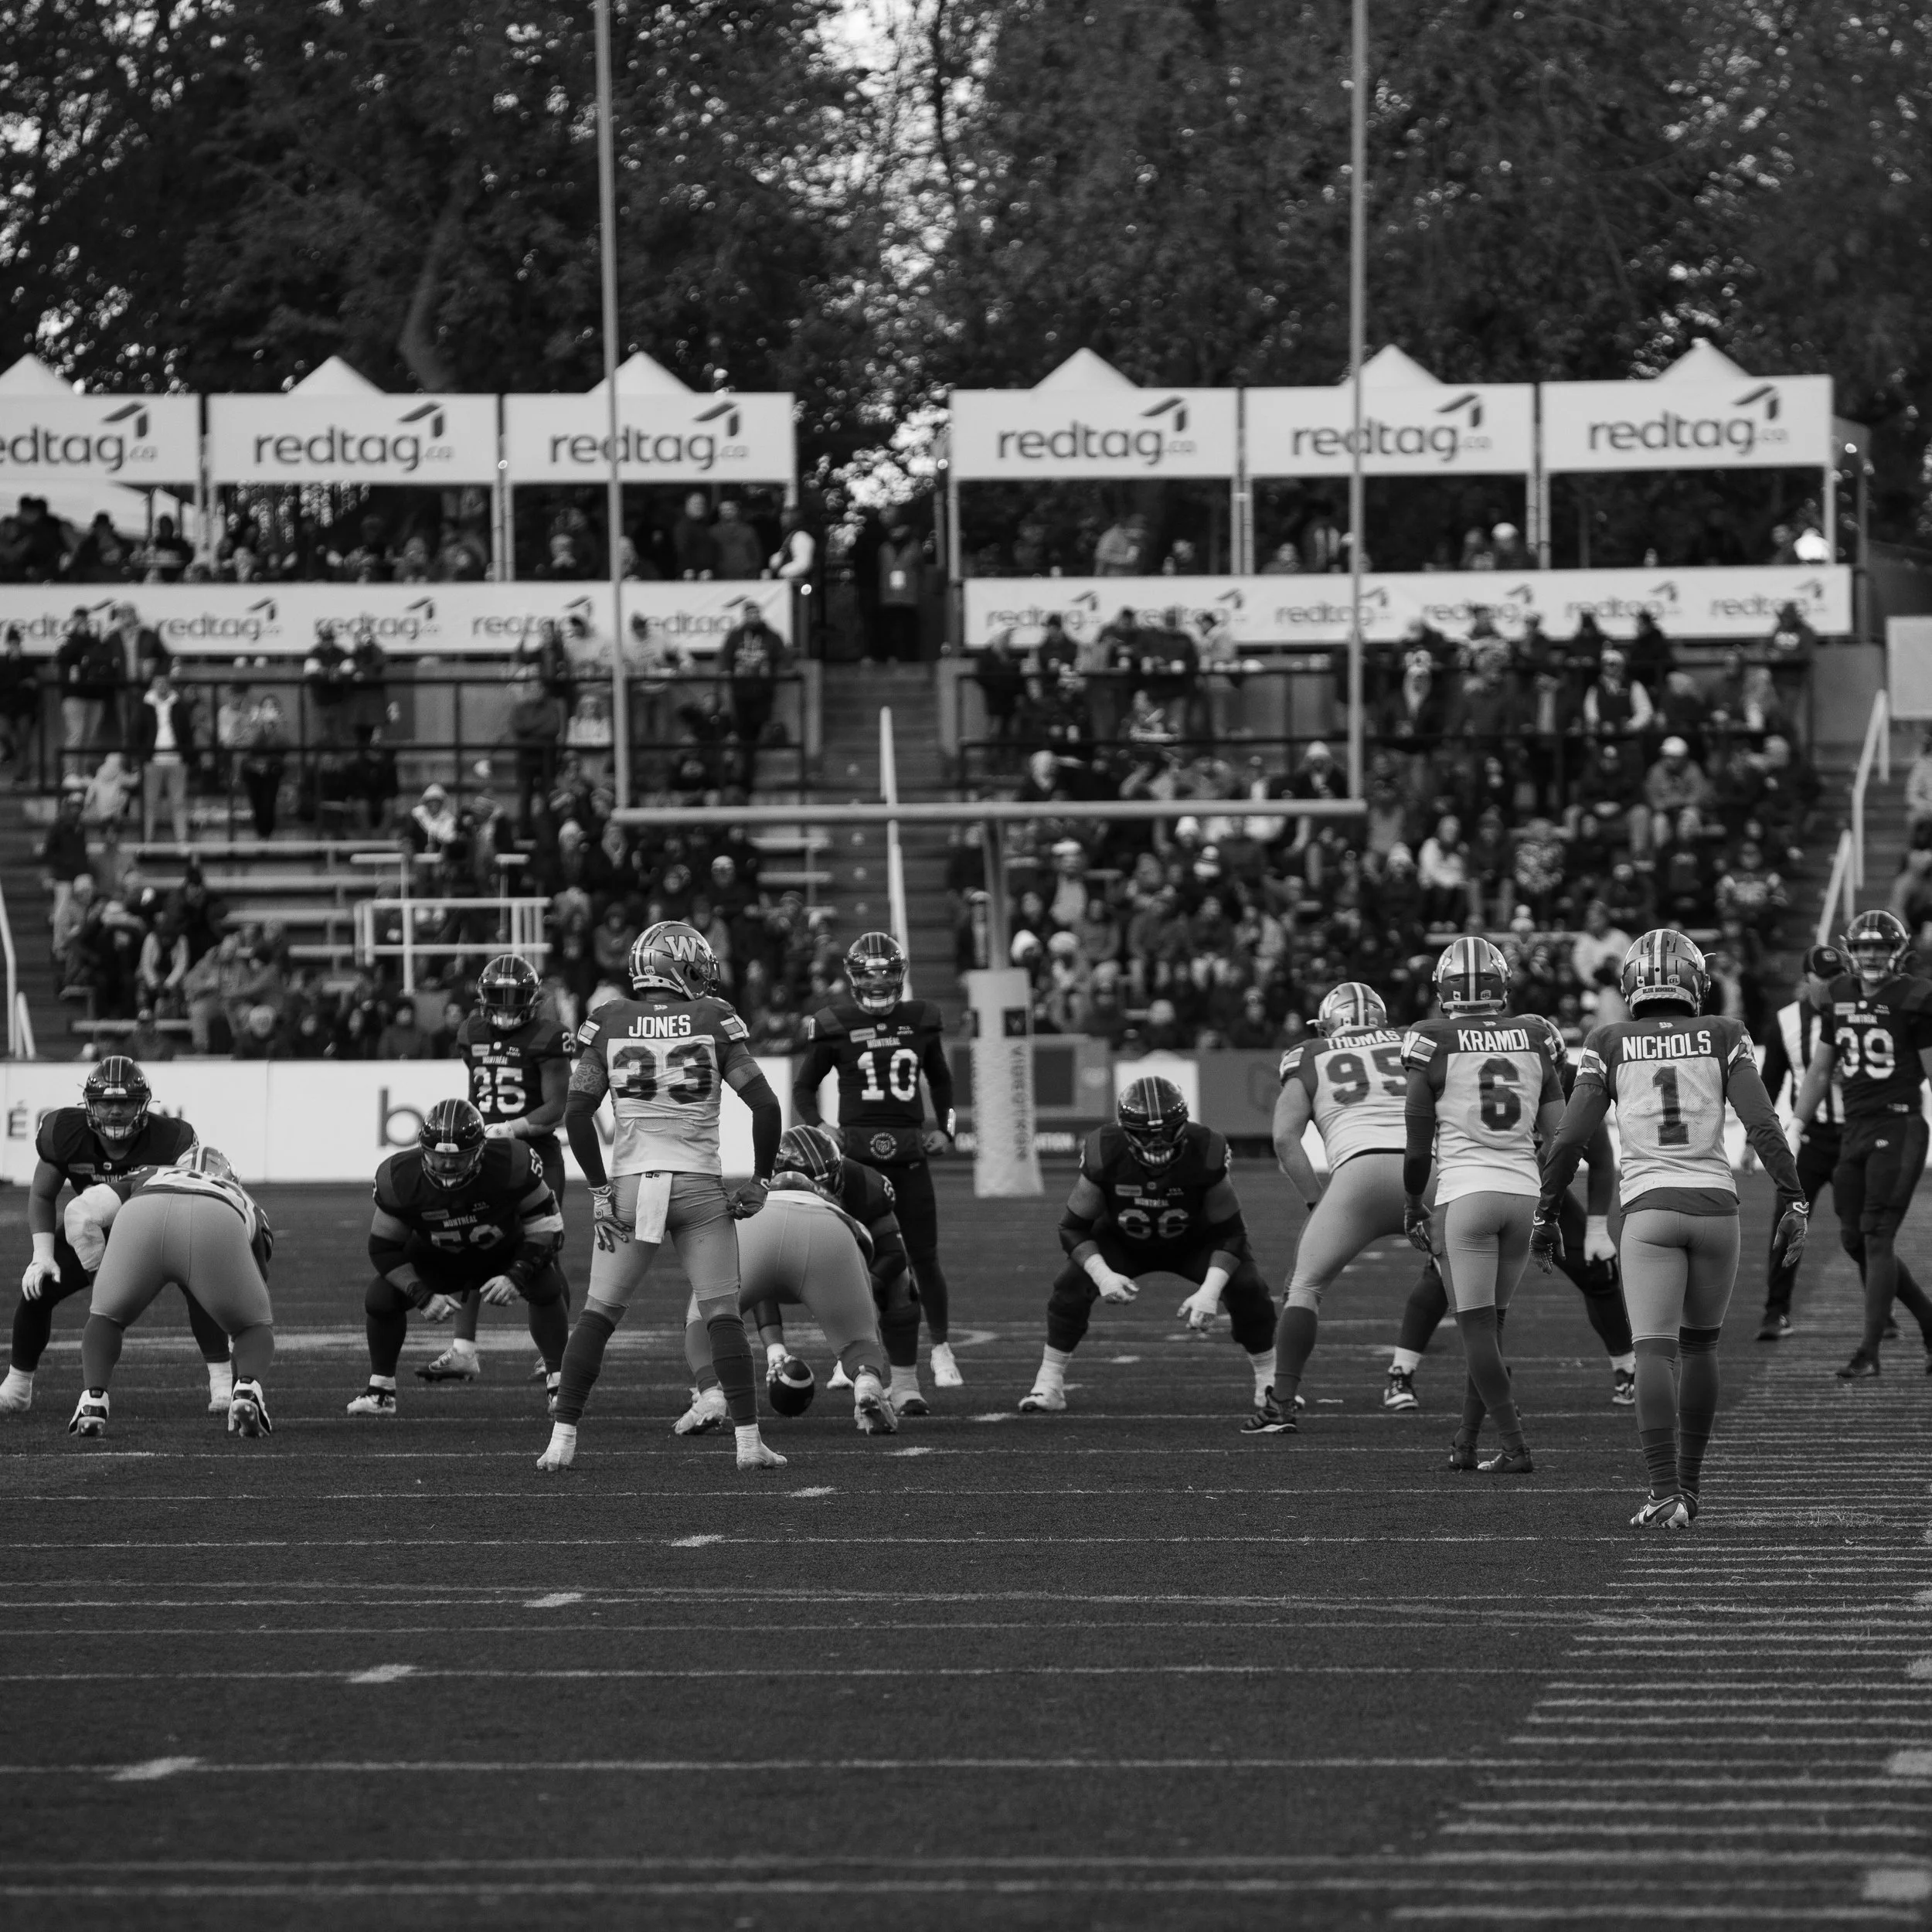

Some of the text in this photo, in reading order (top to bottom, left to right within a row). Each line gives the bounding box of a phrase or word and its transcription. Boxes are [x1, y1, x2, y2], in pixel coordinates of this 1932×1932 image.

[664, 935, 697, 962] W
[628, 1014, 691, 1038] JONES
[1325, 1029, 1401, 1049] THOMAS
[1457, 1029, 1530, 1052] KRAMDI
[1622, 1029, 1712, 1061] NICHOLS
[612, 1043, 713, 1105] 33
[857, 1048, 919, 1102] 10
[1326, 1046, 1407, 1106] 95
[1478, 1058, 1522, 1131] 6
[1652, 1066, 1689, 1146] 1
